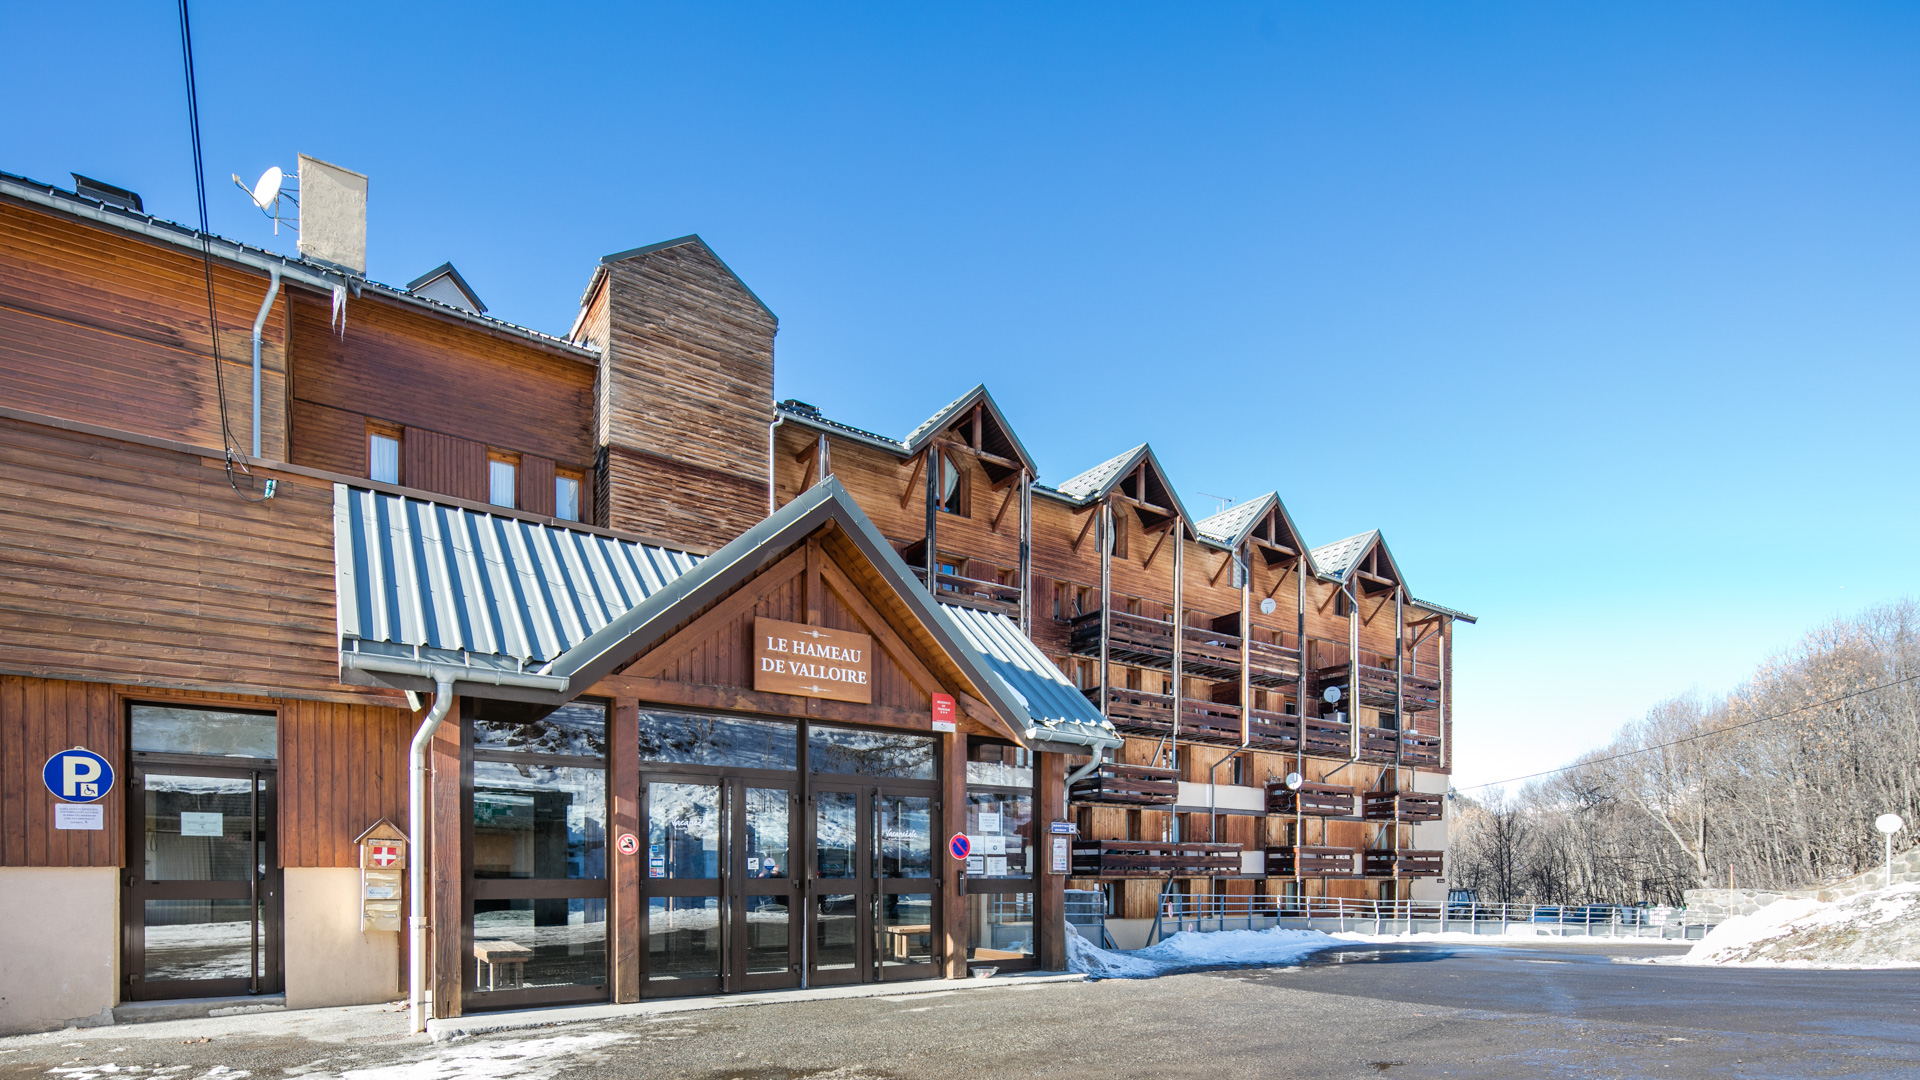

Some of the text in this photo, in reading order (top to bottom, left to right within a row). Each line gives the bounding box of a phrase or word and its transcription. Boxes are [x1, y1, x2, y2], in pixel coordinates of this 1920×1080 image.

[767, 636, 861, 663] LE HAMEAU
[761, 657, 867, 685] DE VALLOIRE
[63, 755, 102, 797] P
